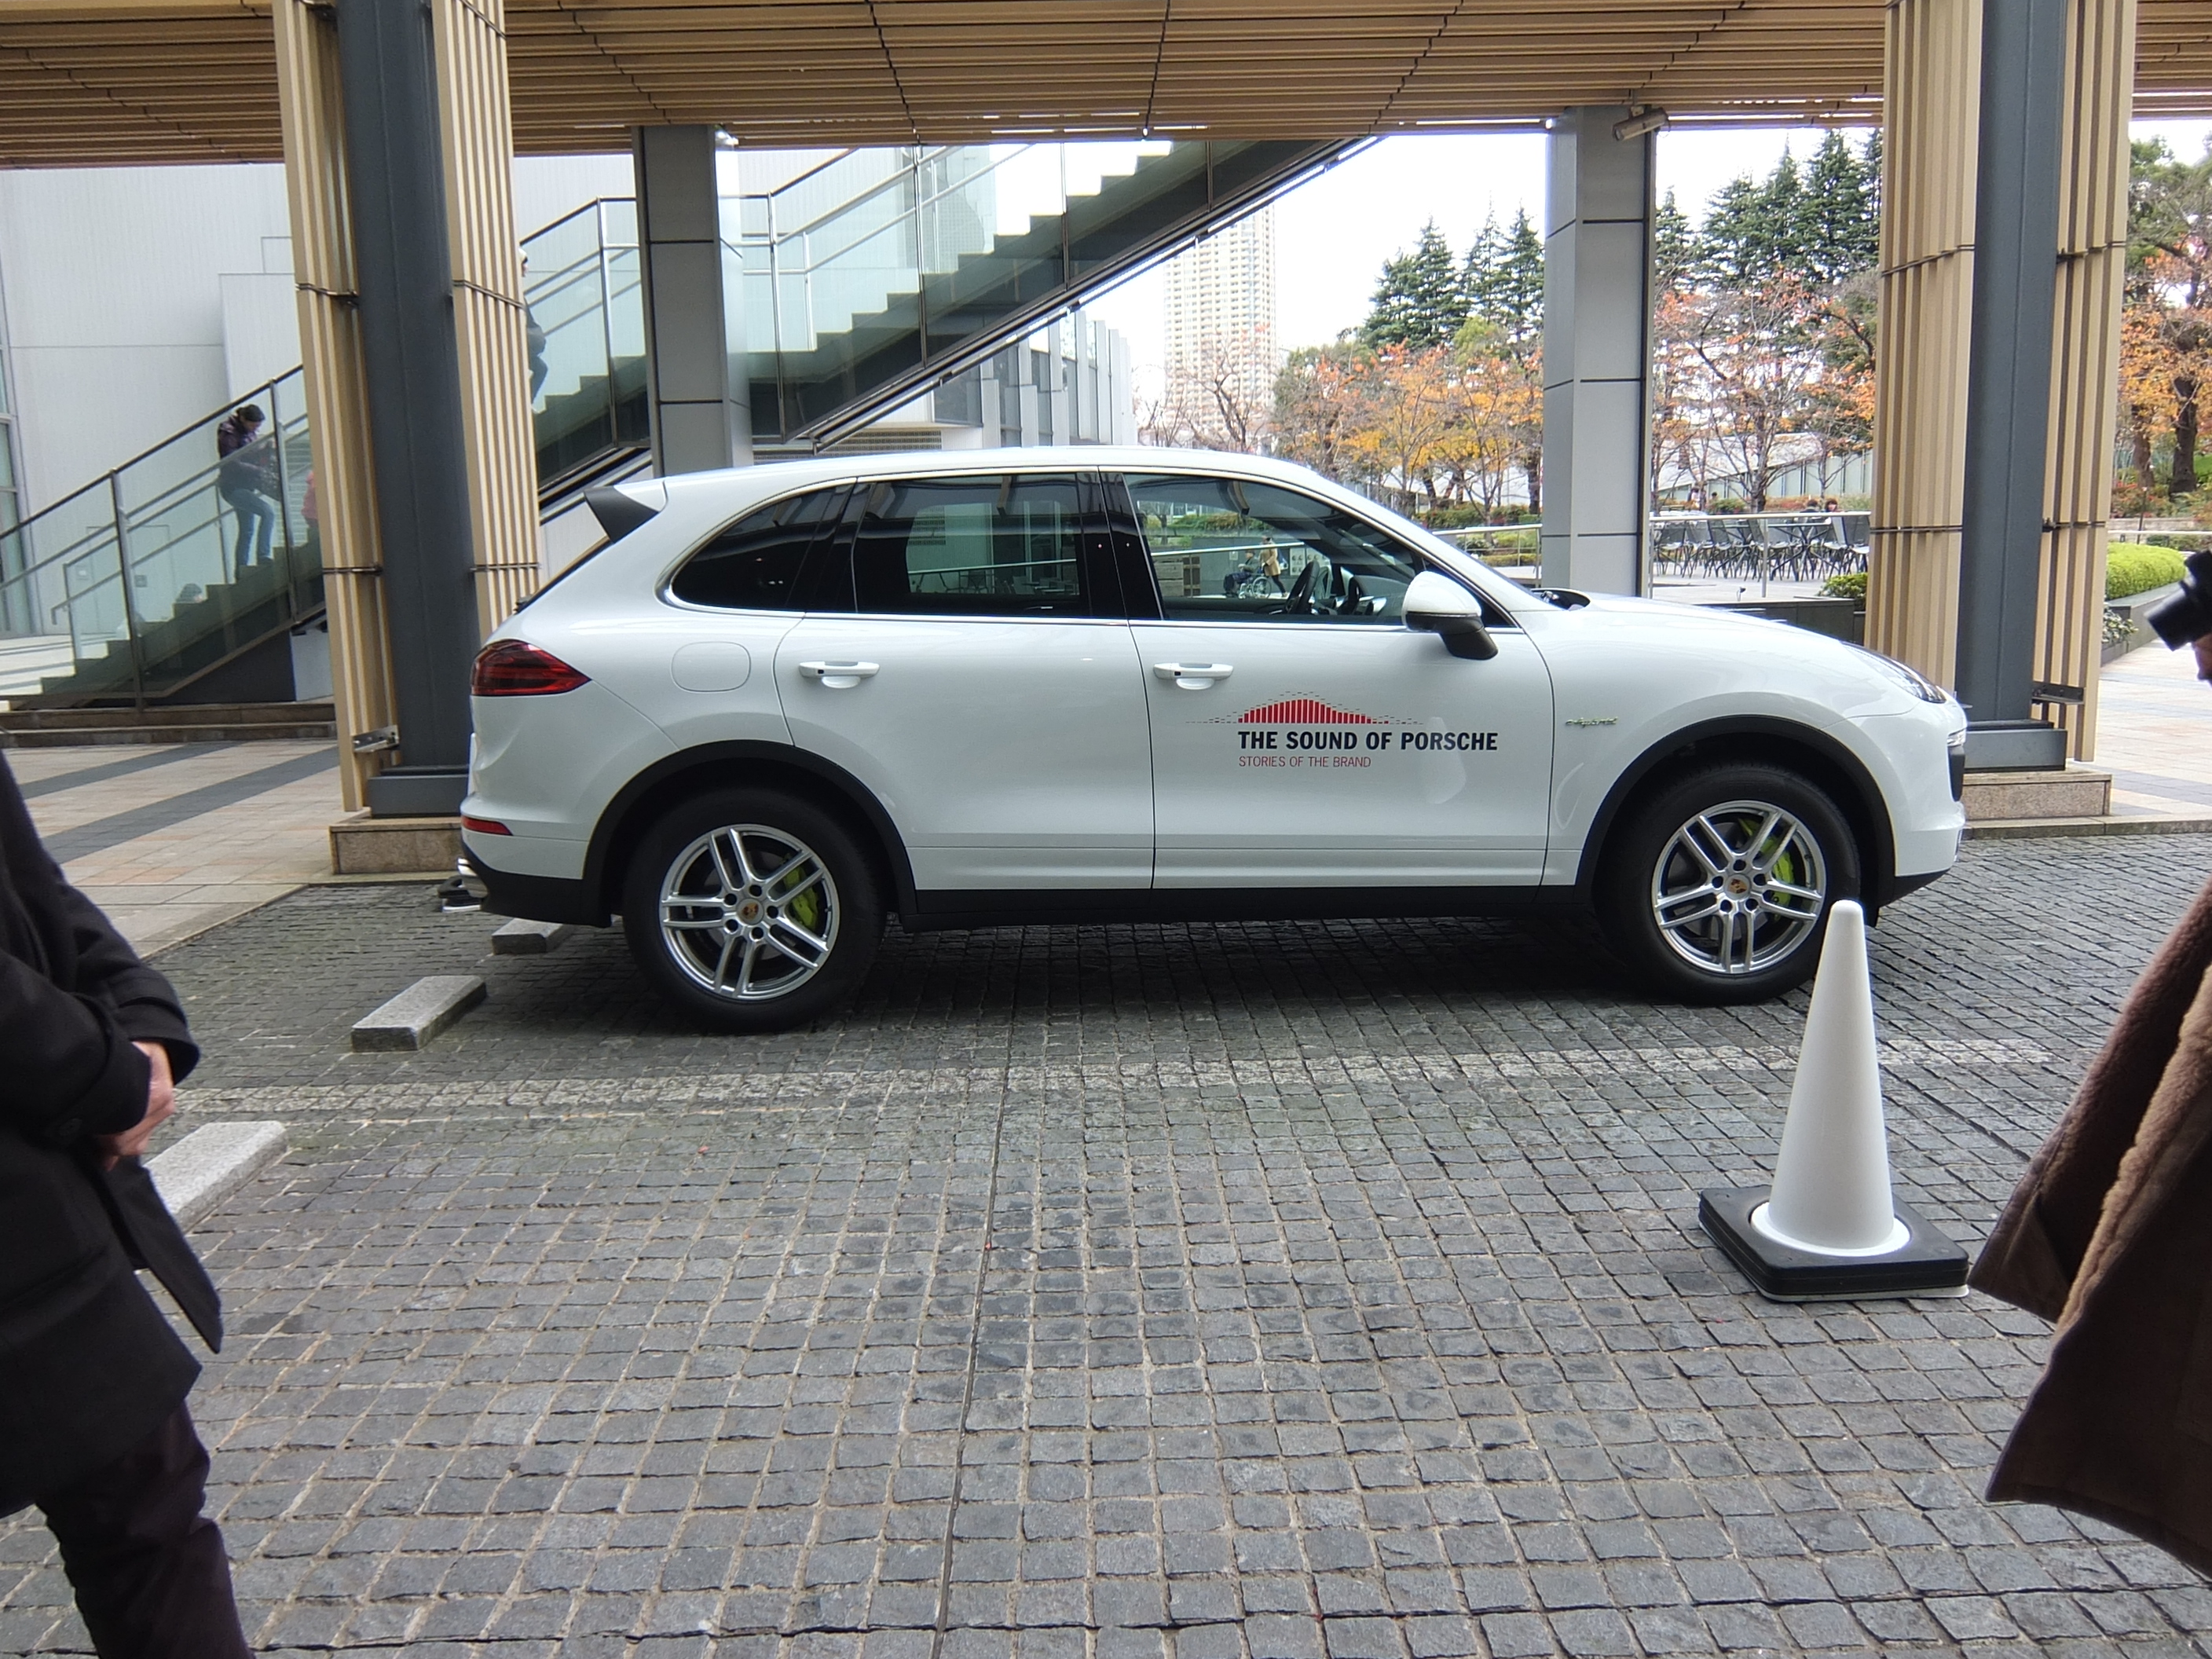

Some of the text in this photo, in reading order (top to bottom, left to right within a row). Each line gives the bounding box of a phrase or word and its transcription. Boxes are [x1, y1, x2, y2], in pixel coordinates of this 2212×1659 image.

[1238, 731, 1499, 751] THE SOUND OF PORSCHE
[1238, 756, 1372, 768] STORIES OF THE BRAND
